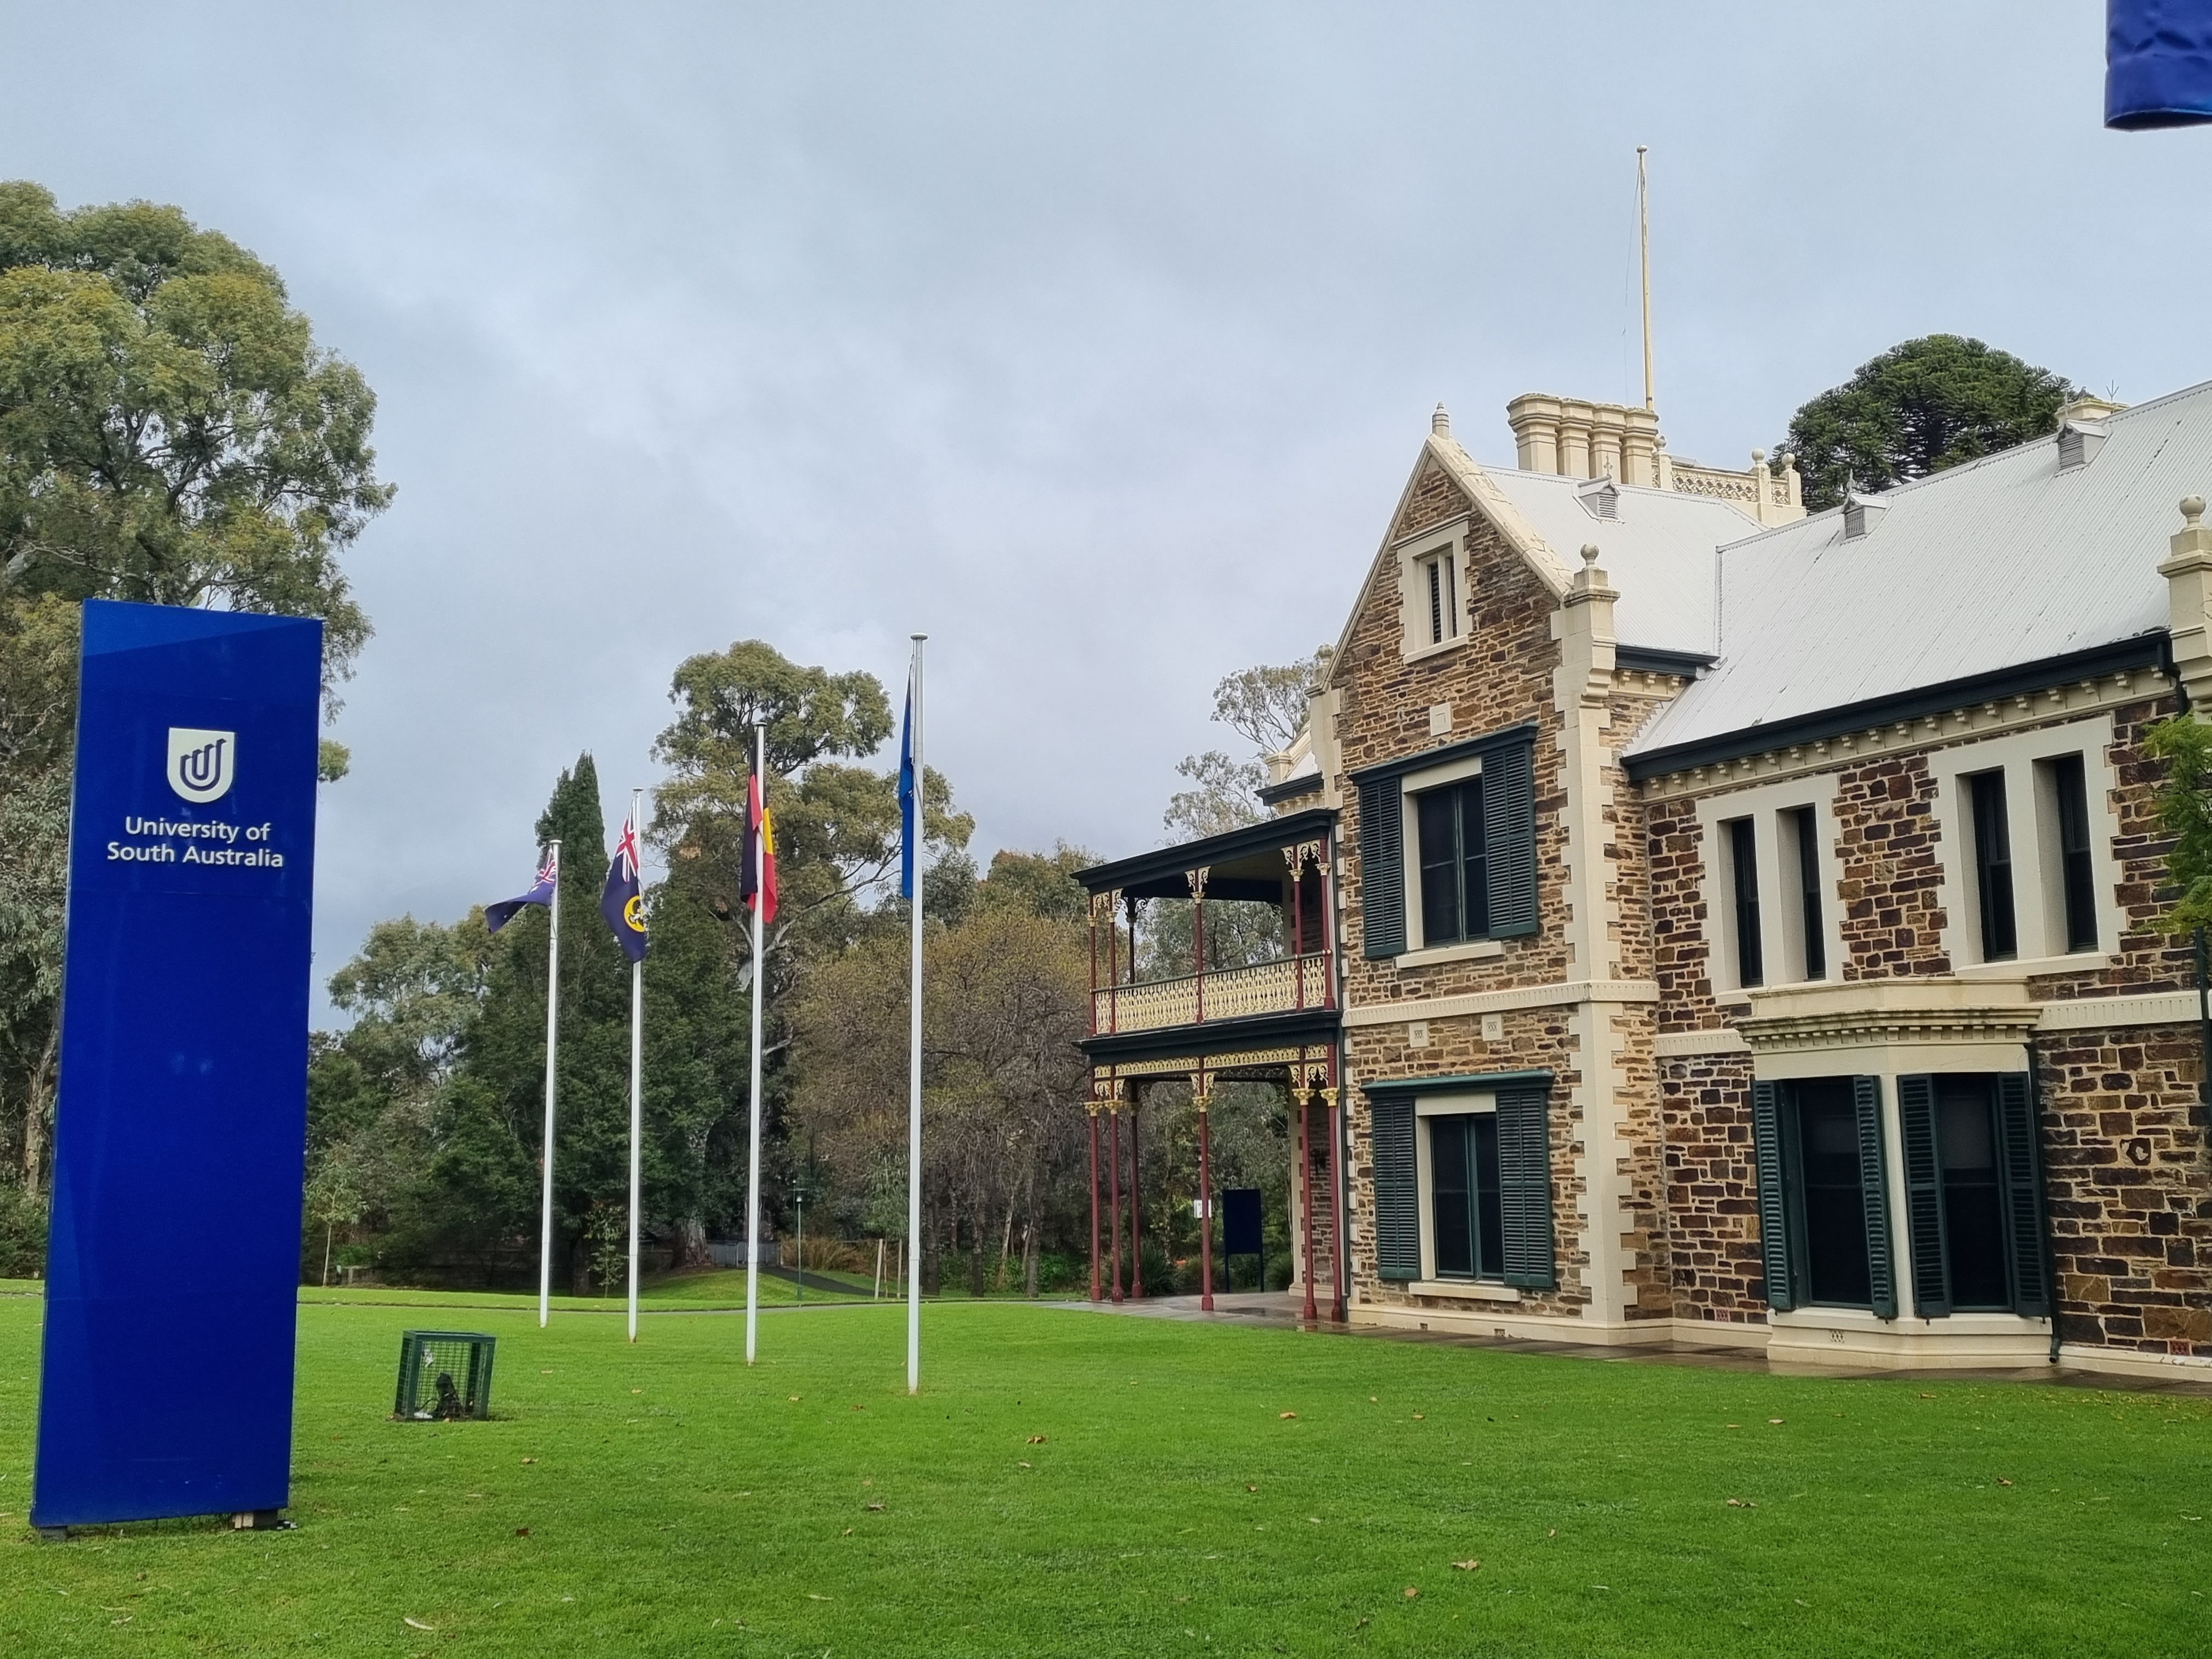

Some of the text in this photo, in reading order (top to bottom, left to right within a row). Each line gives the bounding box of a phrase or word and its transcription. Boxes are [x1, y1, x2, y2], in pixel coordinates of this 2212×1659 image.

[125, 816, 271, 844] University of
[107, 842, 284, 867] South Australia
